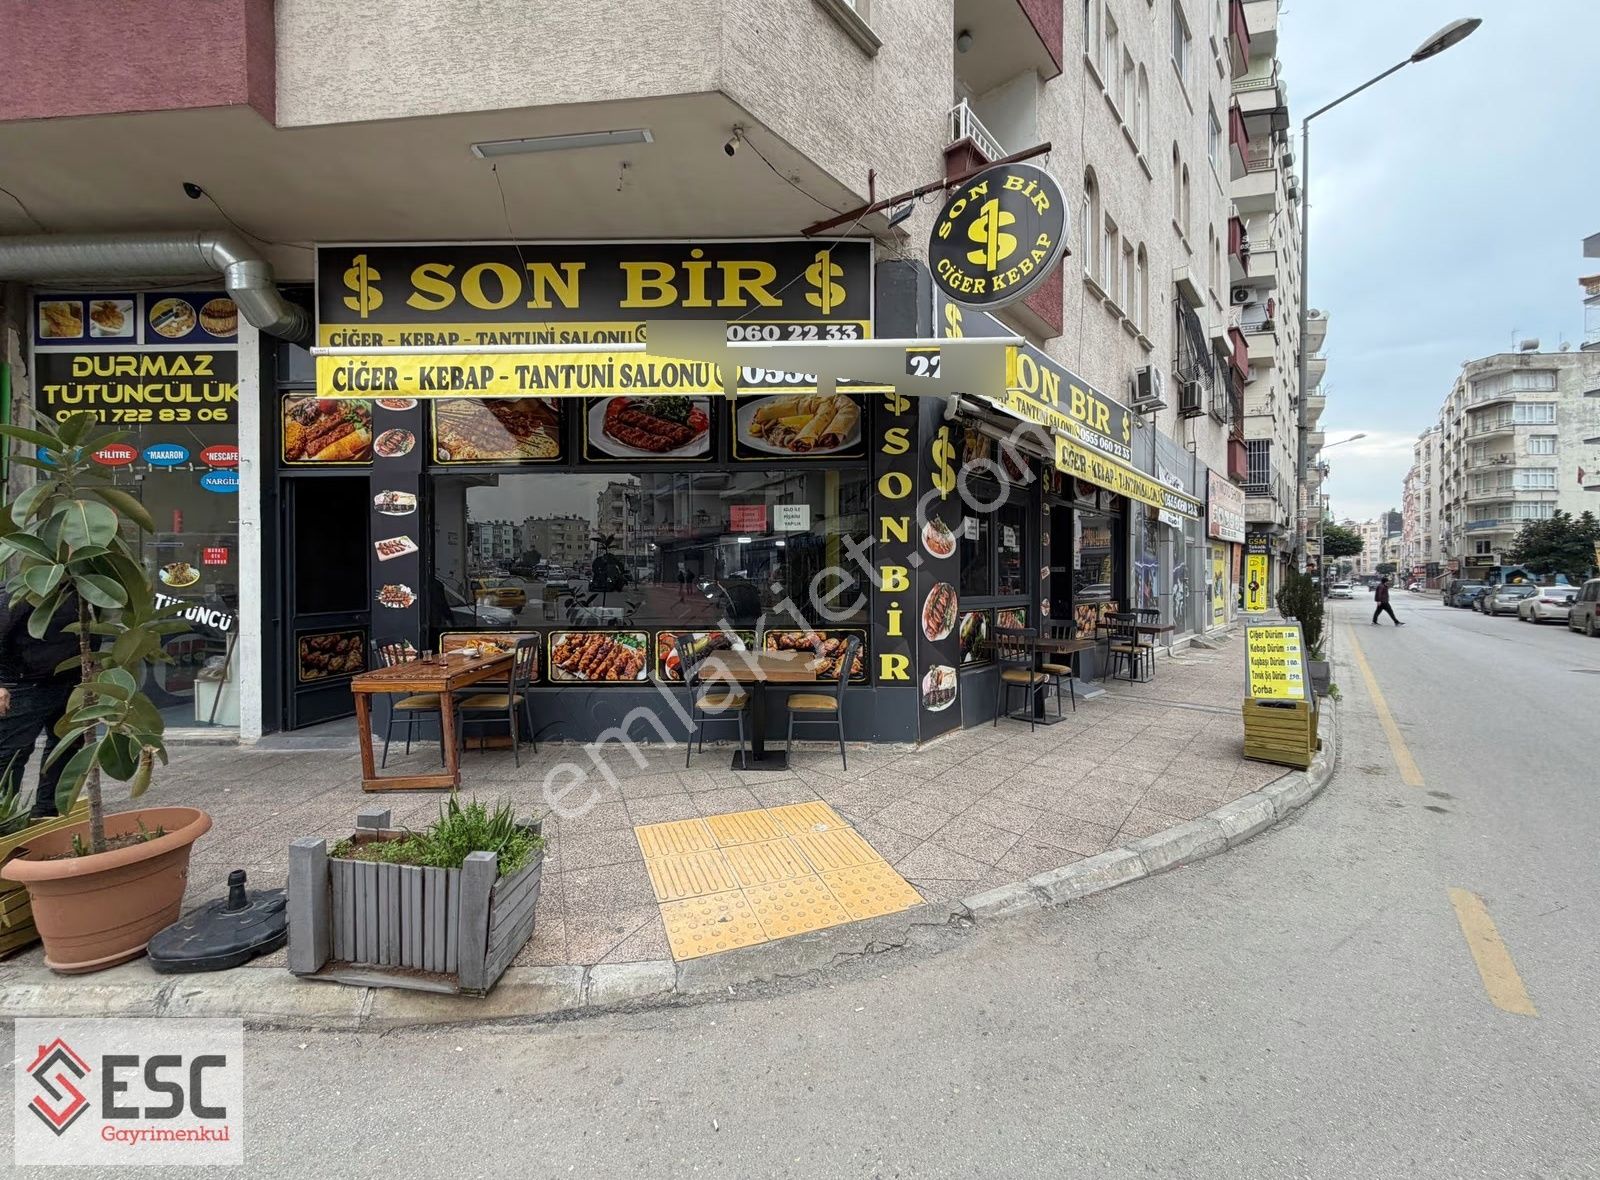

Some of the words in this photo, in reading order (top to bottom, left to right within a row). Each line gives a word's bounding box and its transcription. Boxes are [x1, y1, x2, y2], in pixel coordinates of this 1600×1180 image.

[938, 181, 989, 240] SON
[992, 233, 1052, 292] KEBAP
[406, 262, 586, 311] SON
[620, 248, 783, 308] BİR
[329, 328, 383, 347] CİĞER
[400, 332, 460, 347] KEBAP
[476, 327, 555, 346] TANTUNİ
[560, 329, 632, 346] SALONU
[727, 325, 781, 341] 060
[788, 325, 819, 341] 22
[825, 325, 858, 341] 33
[72, 355, 214, 377] DURMAZ
[332, 360, 399, 392] CİĞER
[419, 365, 495, 391] KEBAP
[515, 357, 614, 390] TANTUNİ
[620, 363, 710, 388] SALONU
[42, 380, 239, 404] TÜTÜNCÜLÜK
[111, 408, 153, 422] 722
[159, 408, 191, 422] 83
[197, 408, 229, 422] 06
[1069, 388, 1111, 435] BİR
[1080, 427, 1098, 446] 0555
[1099, 436, 1114, 452] 060
[1114, 443, 1122, 457] 22
[1252, 684, 1273, 696] Çorba
